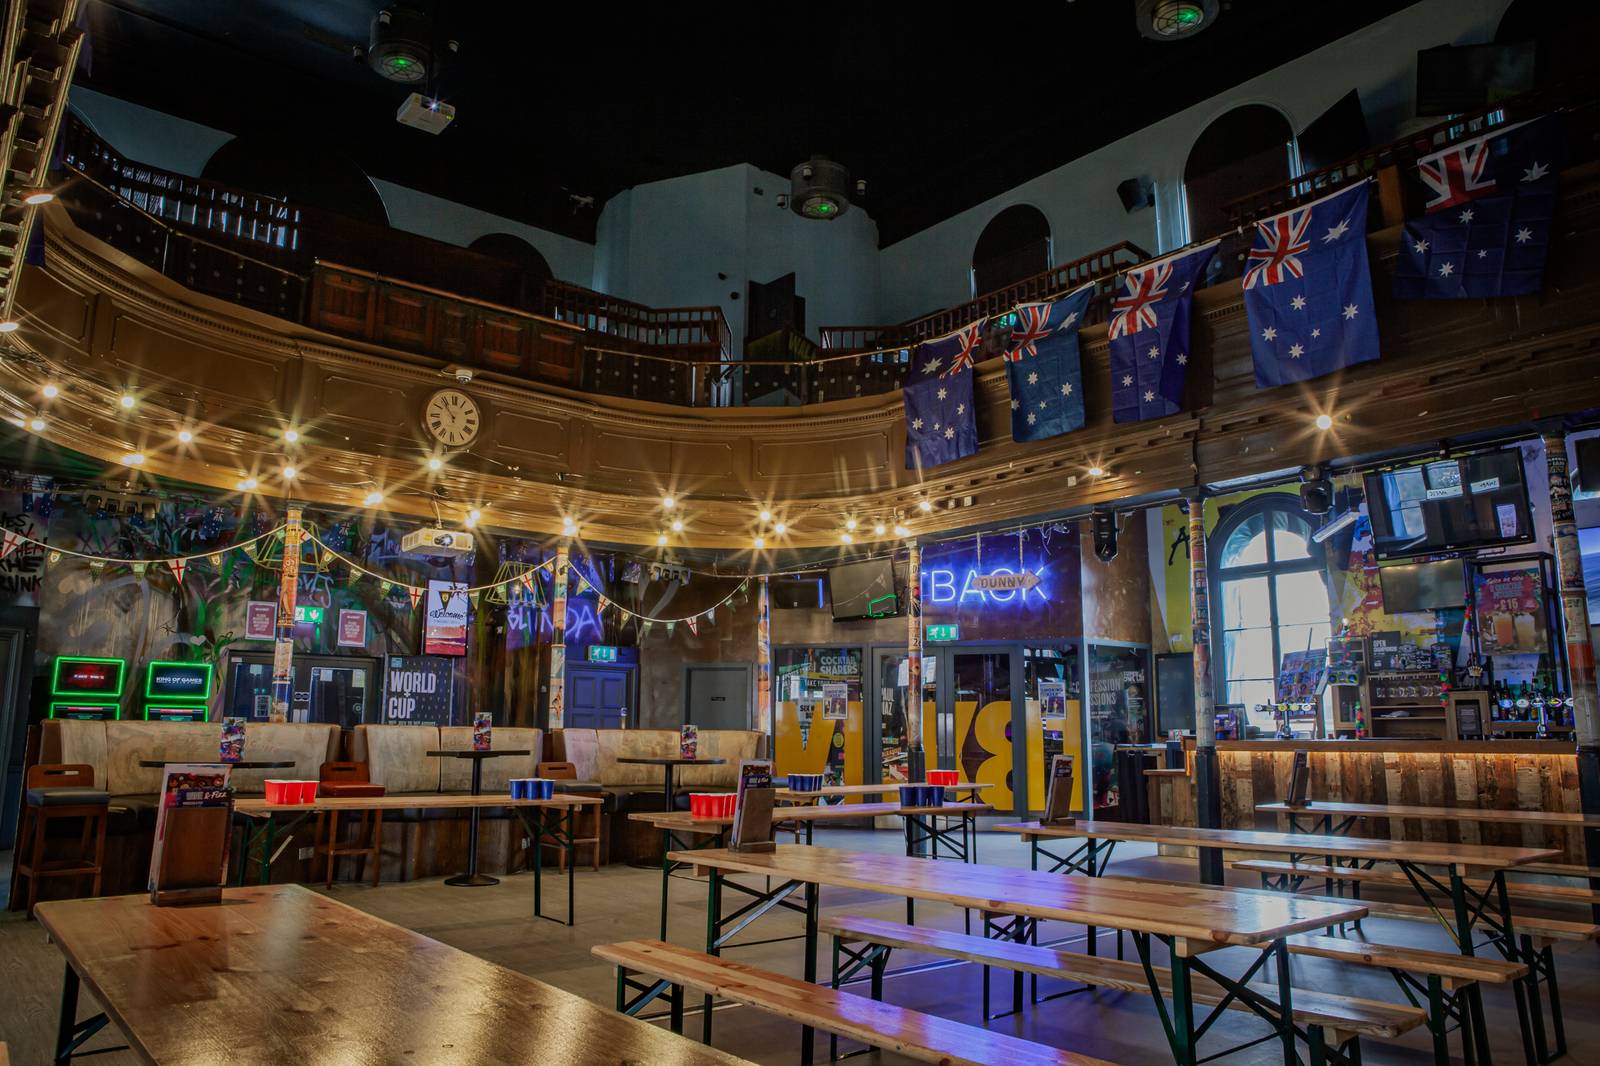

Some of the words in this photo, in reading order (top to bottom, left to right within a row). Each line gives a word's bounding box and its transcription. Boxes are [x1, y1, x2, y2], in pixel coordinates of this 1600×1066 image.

[922, 566, 1048, 602] BACK
[980, 577, 1025, 589] DUNNY
[820, 656, 857, 665] COCKTAIL
[390, 670, 437, 693] WORLD
[388, 697, 416, 719] CUP
